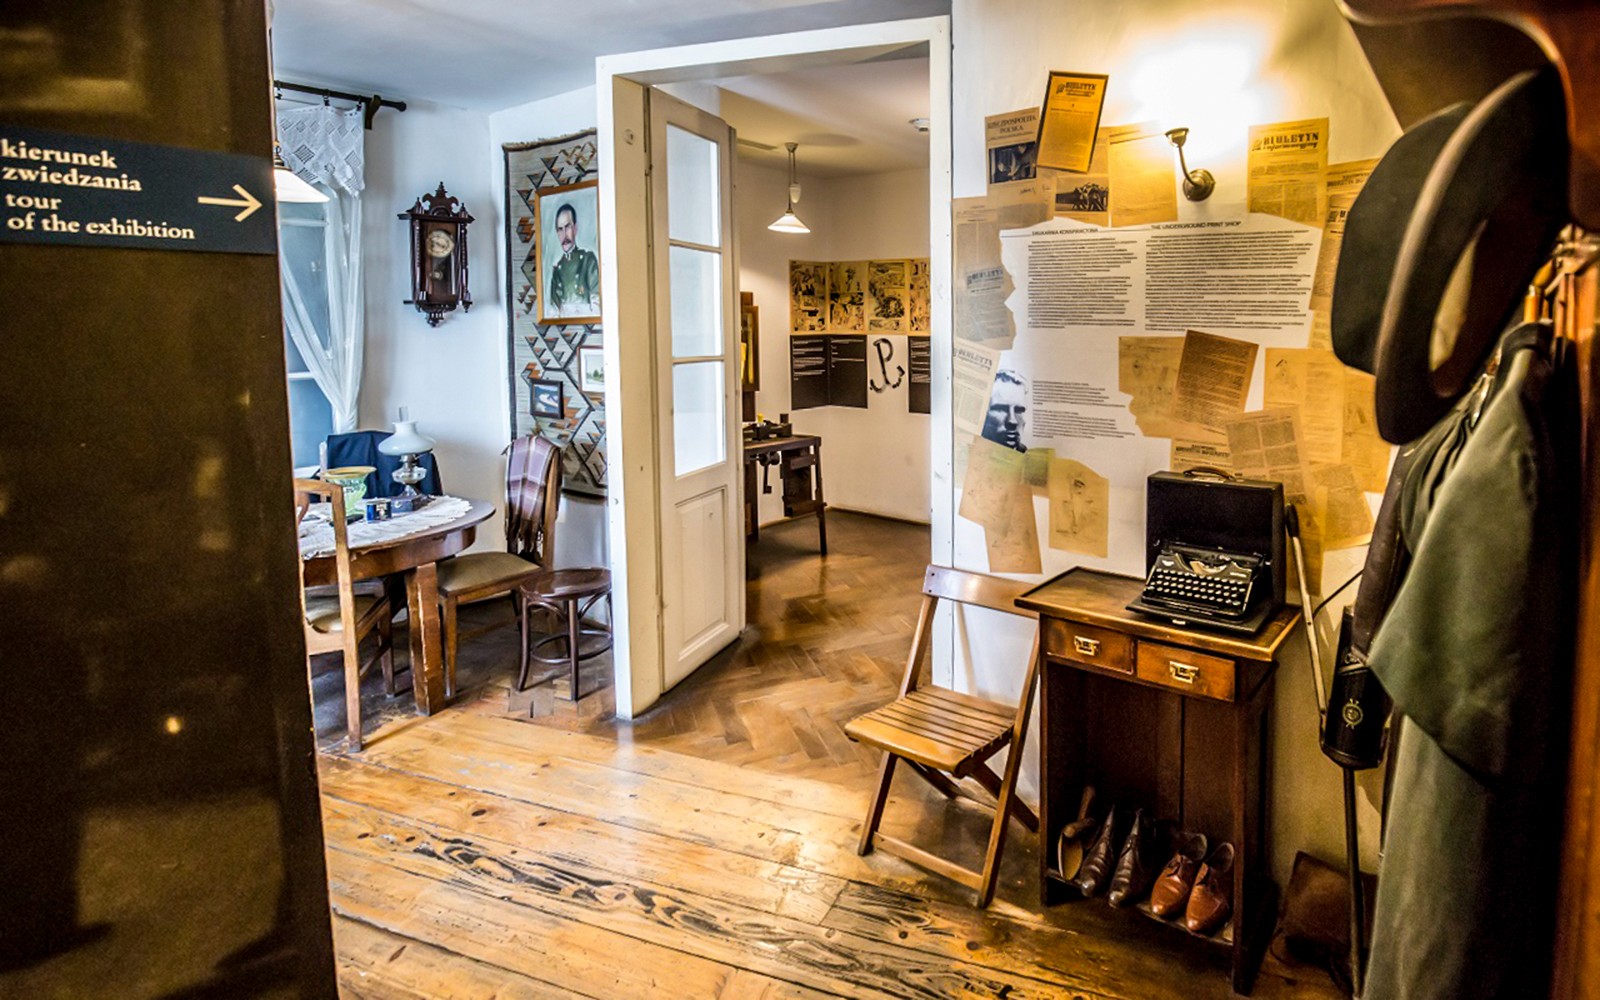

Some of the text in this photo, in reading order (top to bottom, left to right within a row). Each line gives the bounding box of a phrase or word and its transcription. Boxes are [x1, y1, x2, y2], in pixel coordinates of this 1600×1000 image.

[1263, 132, 1319, 145] BIULETYN
[1, 138, 118, 169] kierunek
[2, 166, 142, 192] zwiedzania
[5, 193, 62, 210] tour
[7, 211, 195, 240] of the exhibition
